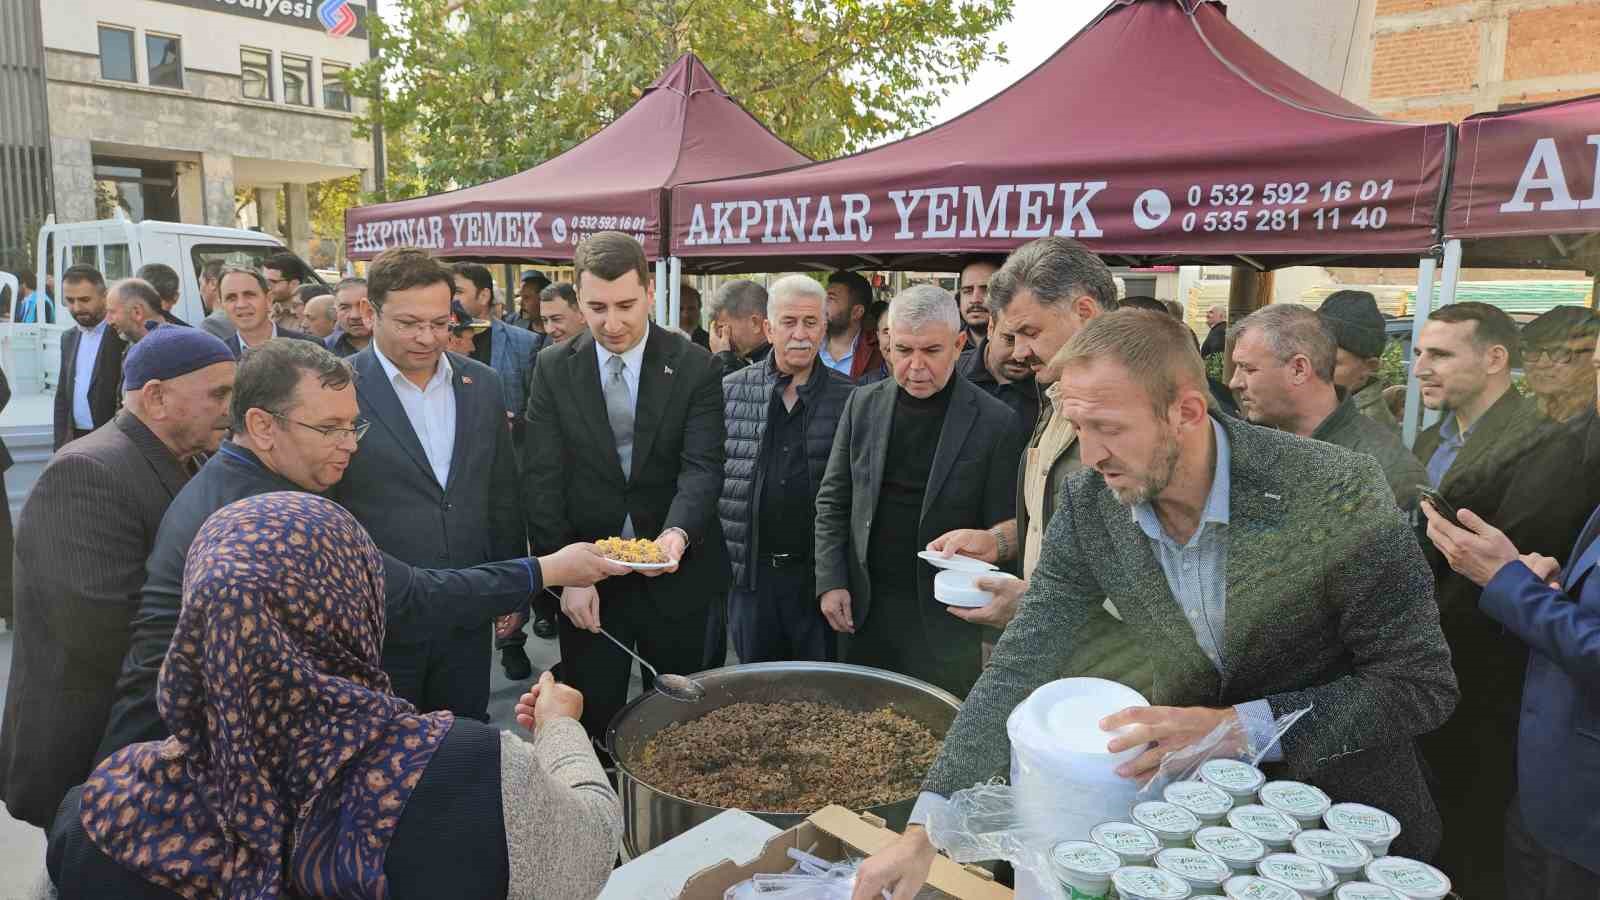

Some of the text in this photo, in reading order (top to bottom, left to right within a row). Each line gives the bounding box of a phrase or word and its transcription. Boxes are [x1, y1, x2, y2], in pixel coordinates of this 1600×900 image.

[1187, 179, 1394, 206] 0 532 592 16 01
[1500, 134, 1600, 212] A
[353, 212, 543, 252] AKPINAR YEMEK
[685, 181, 1108, 245] AKPINAR YEMEK
[1181, 206, 1388, 232] 0 535 281 11 40
